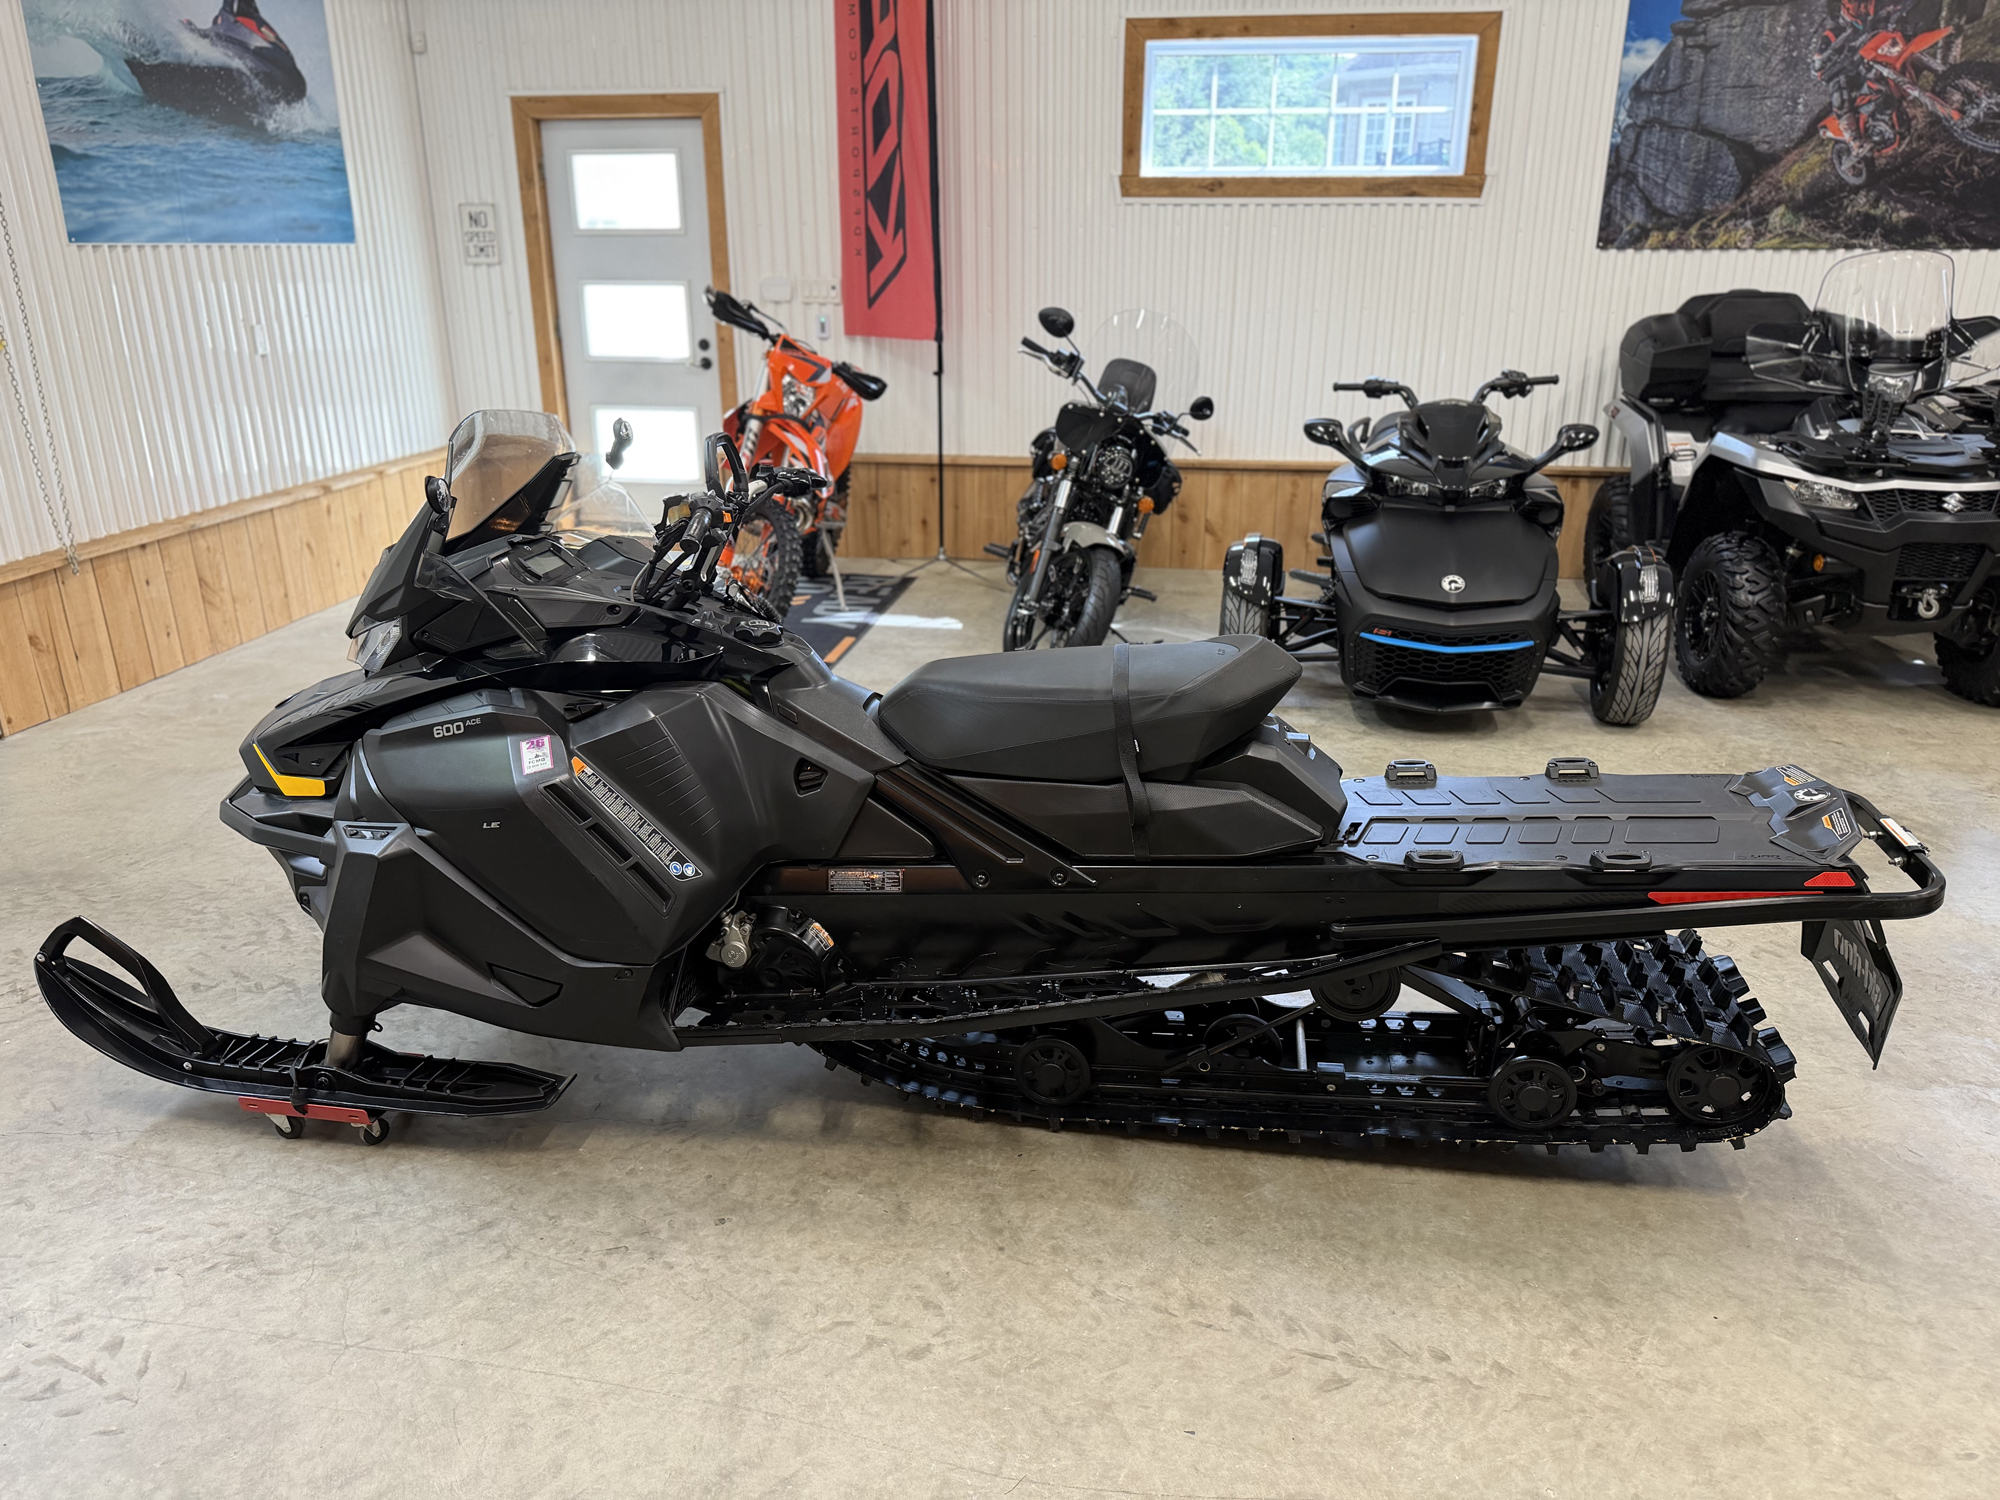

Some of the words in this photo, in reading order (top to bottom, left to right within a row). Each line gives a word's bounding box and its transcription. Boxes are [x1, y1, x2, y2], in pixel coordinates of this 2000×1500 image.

[467, 210, 488, 228] NO
[433, 721, 465, 738] 600
[465, 717, 482, 726] ACE
[526, 738, 546, 750] 26
[482, 821, 501, 829] LE
